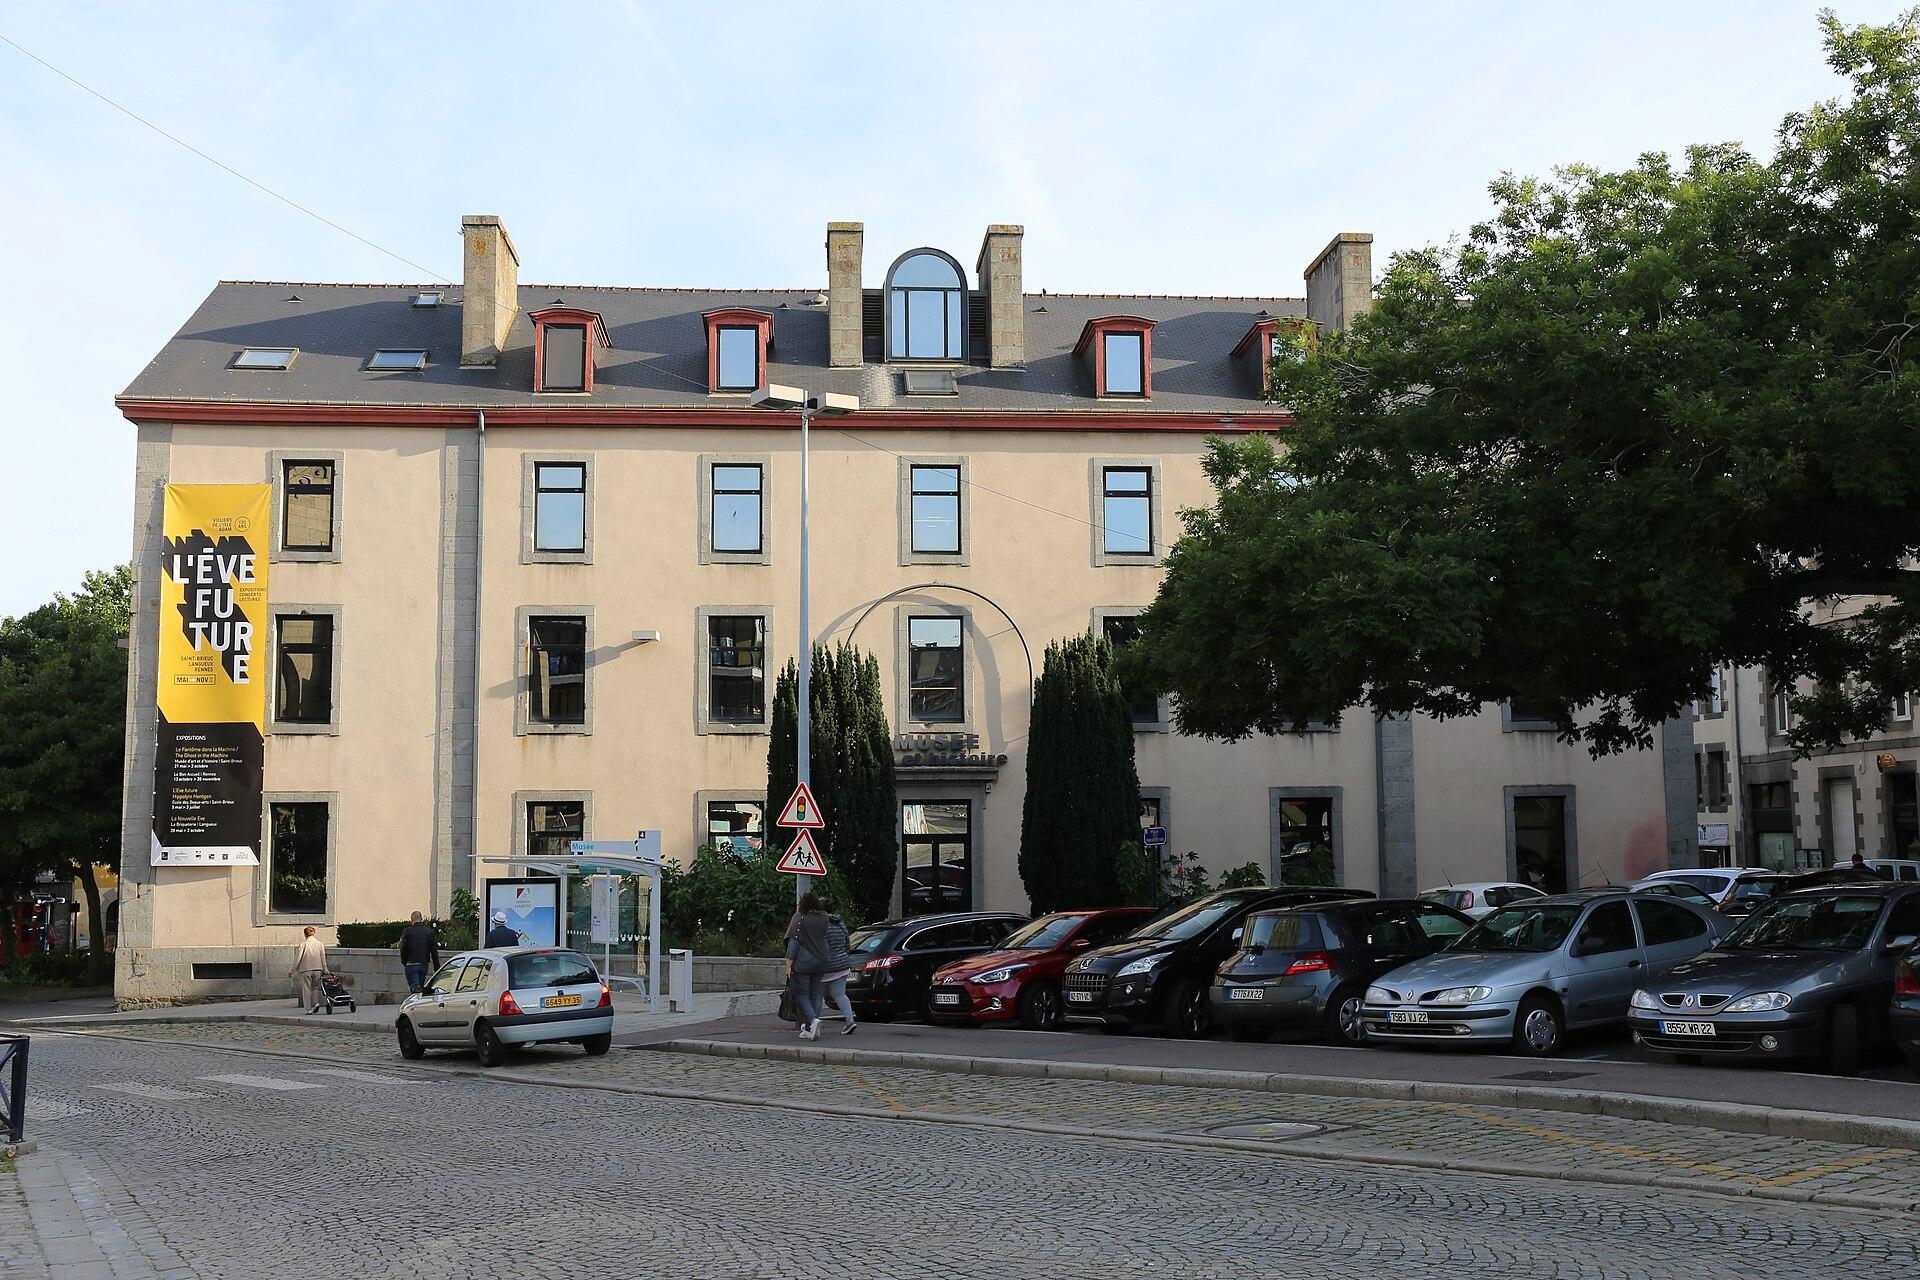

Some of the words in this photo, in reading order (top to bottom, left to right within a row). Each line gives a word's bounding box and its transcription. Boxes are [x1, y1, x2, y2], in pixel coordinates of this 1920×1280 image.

[196, 589, 233, 618] FU
[189, 622, 253, 651] TUR
[234, 655, 250, 684] E
[1418, 1014, 1427, 1022] 22
[1667, 1023, 1687, 1033] 8552
[1701, 1024, 1712, 1034] 22
